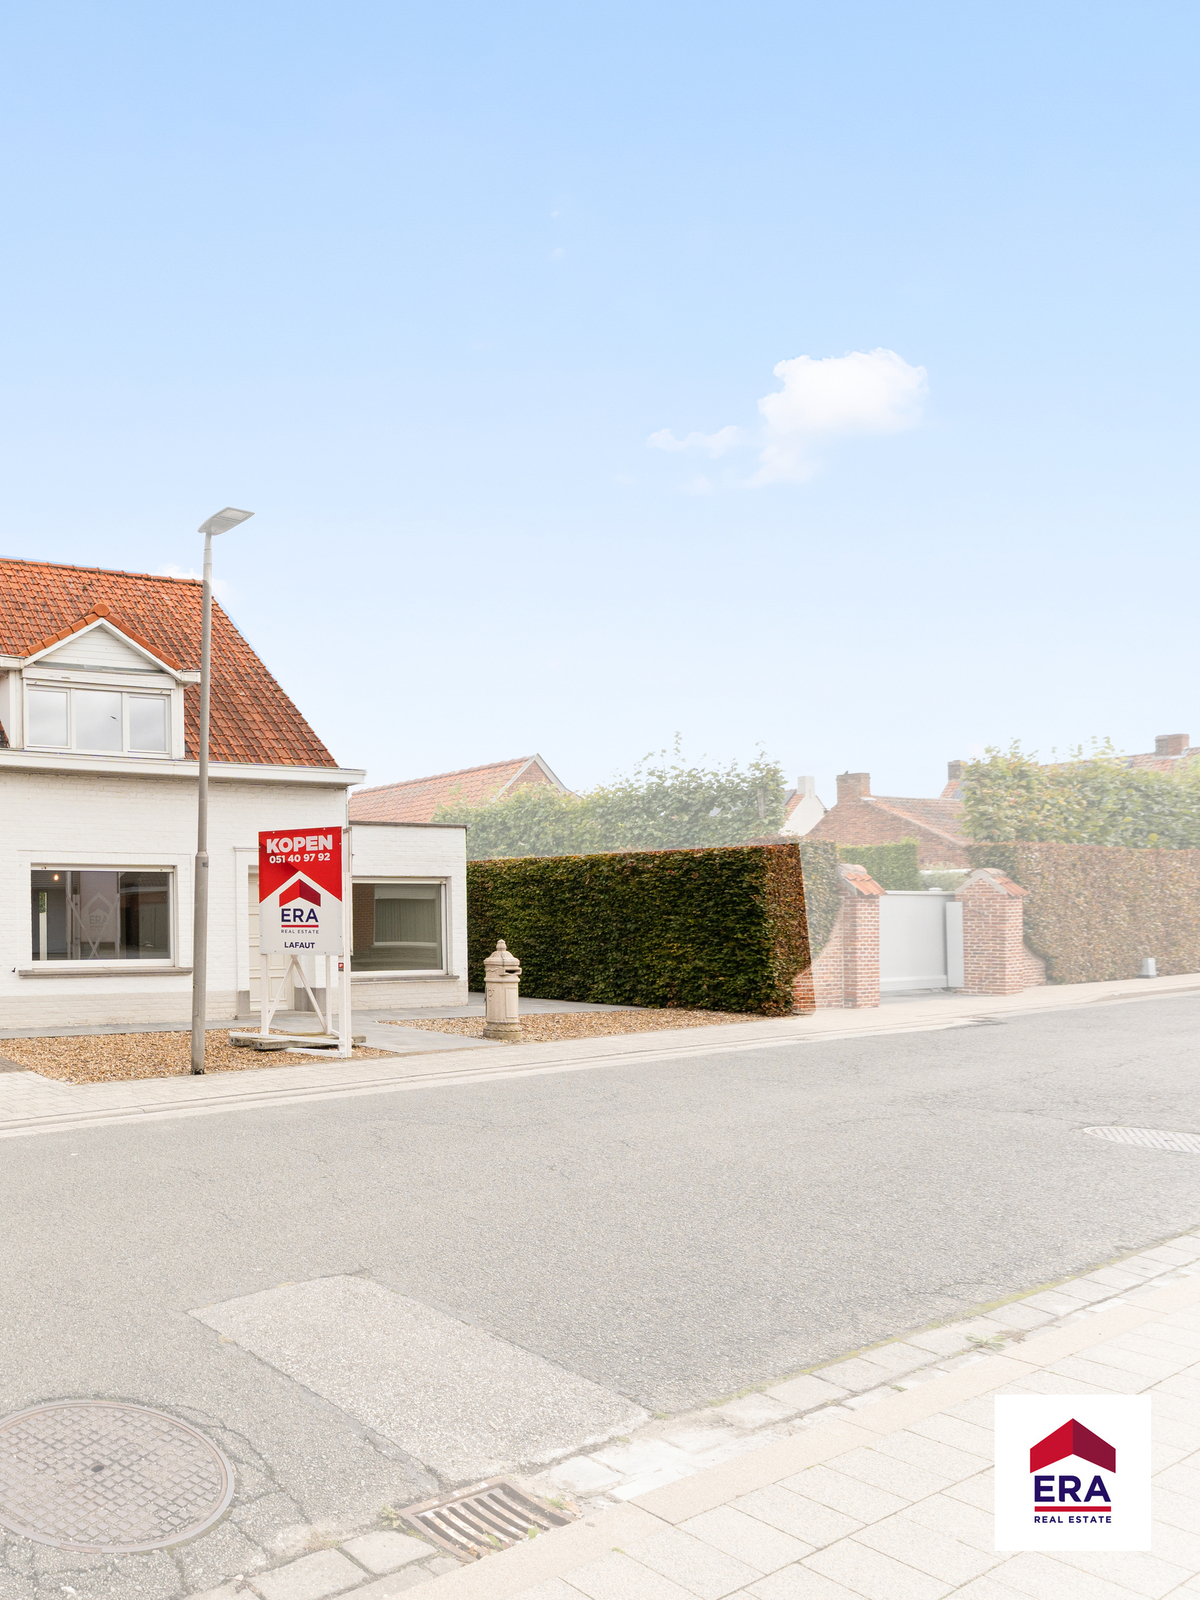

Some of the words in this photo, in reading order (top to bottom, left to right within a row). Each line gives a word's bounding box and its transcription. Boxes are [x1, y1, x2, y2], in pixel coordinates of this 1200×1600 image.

[266, 834, 333, 854] KOPEN
[269, 855, 286, 864] 051
[287, 854, 301, 863] 40
[303, 853, 316, 862] 97
[318, 852, 331, 861] 92
[281, 908, 319, 922] ERA
[284, 941, 316, 949] LAFAUT
